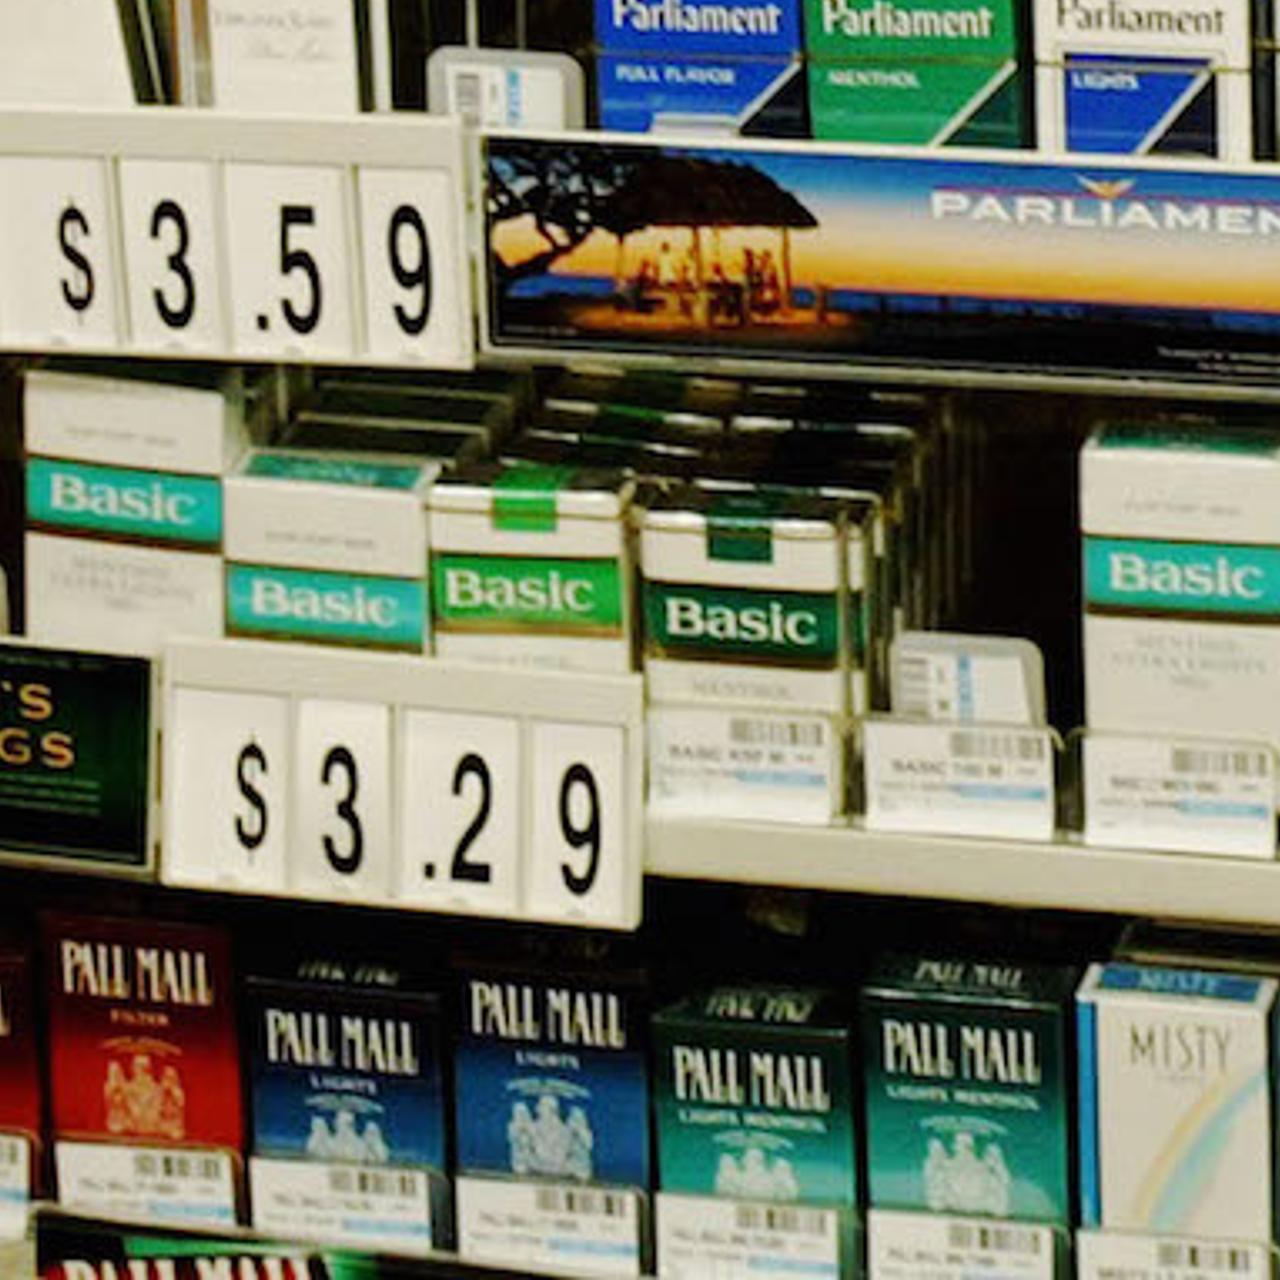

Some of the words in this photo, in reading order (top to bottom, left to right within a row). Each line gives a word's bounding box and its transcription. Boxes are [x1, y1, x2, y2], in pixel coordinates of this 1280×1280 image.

[615, 65, 660, 84] FULL
[666, 67, 735, 85] FLAVOR
[827, 70, 919, 89] MENTHOL
[1071, 71, 1140, 91] LIGHTS
[50, 471, 197, 525] Basic
[446, 568, 595, 614] Basic
[1109, 552, 1265, 600] Basic
[252, 577, 399, 628] Basic
[666, 597, 818, 646] Basic
[61, 939, 131, 1000] PALL
[136, 946, 214, 1007] MALL
[470, 981, 542, 1041] PALL
[547, 988, 626, 1050] MALL
[265, 1008, 336, 1067] PALL
[341, 1015, 420, 1076] MALL
[513, 1050, 581, 1071] LIGHTS
[883, 1019, 956, 1081] PALL
[961, 1026, 1042, 1087] MALL
[1128, 1023, 1232, 1076] MISTY
[310, 1076, 379, 1095] LIGHTS
[673, 1045, 746, 1107] PALL
[750, 1050, 831, 1113] MALL
[886, 1083, 949, 1103] LIGHTS
[953, 1087, 1040, 1111] MENTHOL
